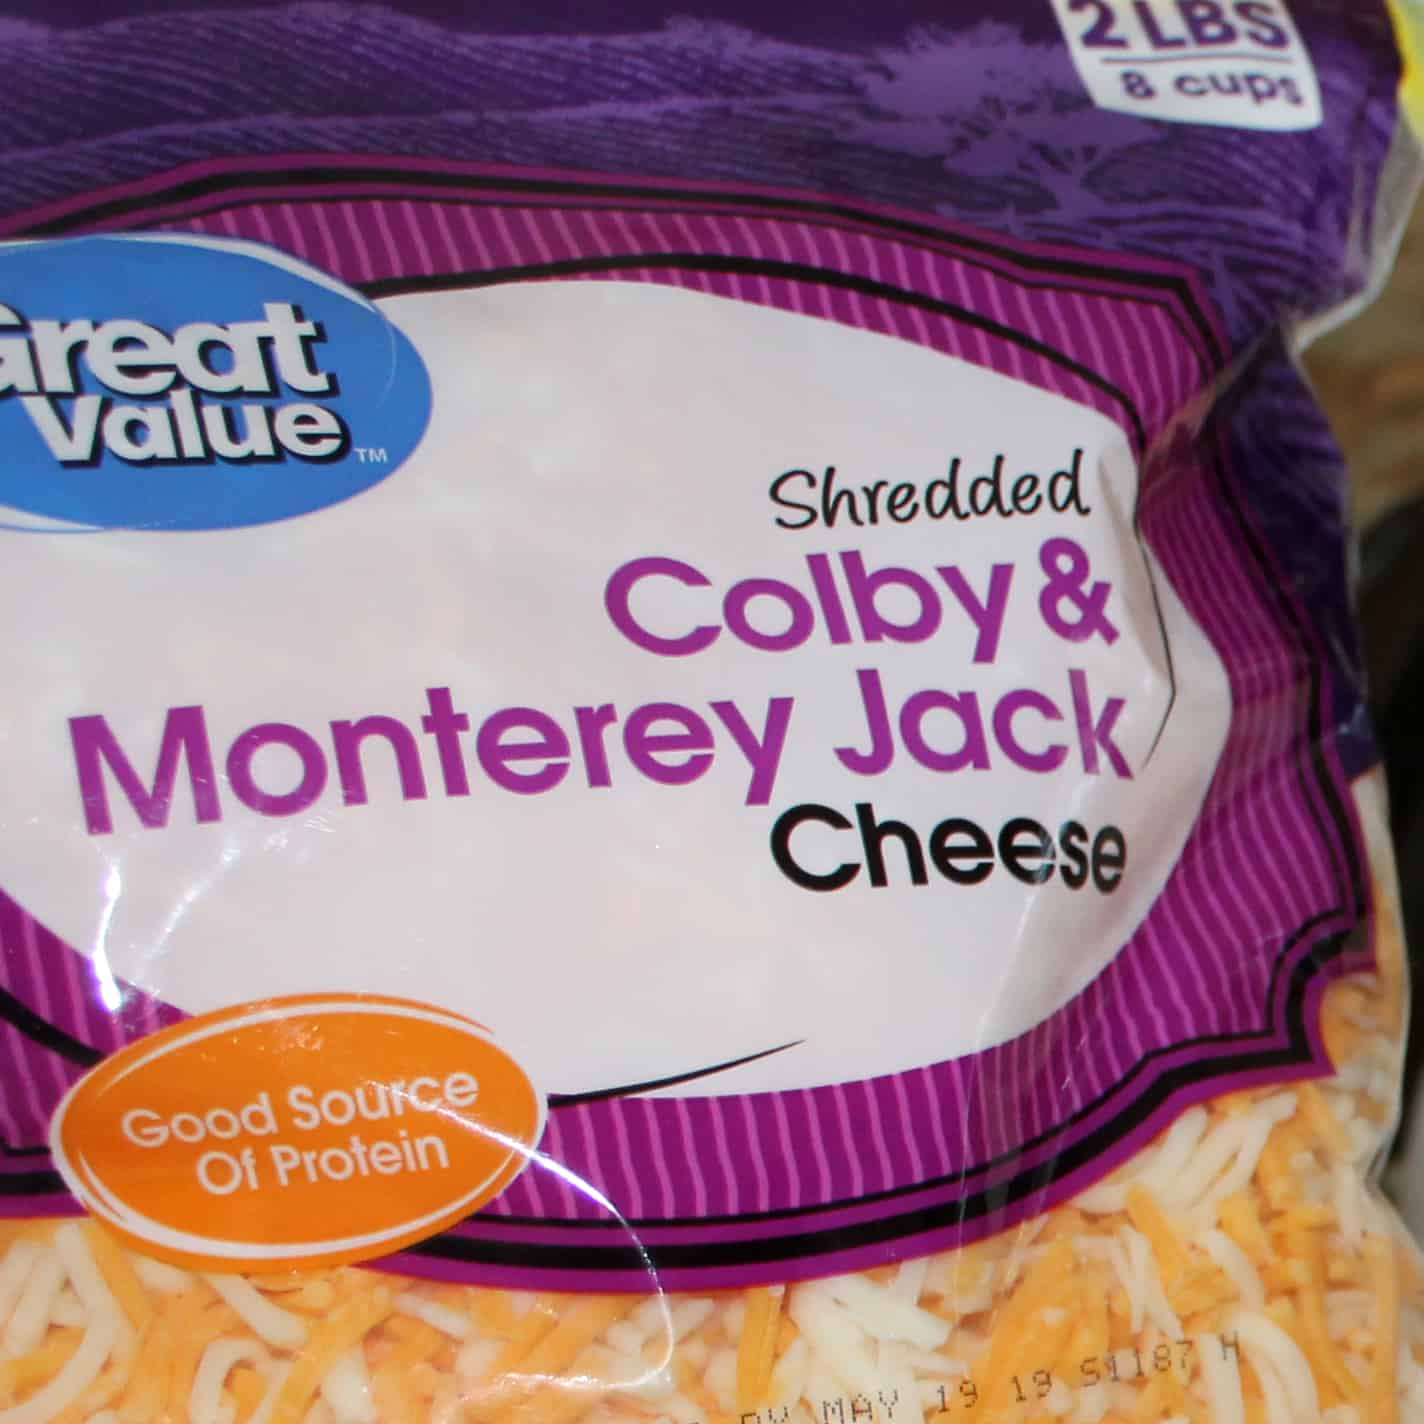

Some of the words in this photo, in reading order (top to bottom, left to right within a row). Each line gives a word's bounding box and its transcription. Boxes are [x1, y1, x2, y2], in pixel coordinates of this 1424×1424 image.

[1174, 72, 1303, 106] cups
[20, 388, 348, 466] Value
[769, 448, 1091, 530] Shredded
[603, 550, 1015, 664] Colby
[1038, 536, 1119, 646] &
[68, 686, 795, 835] Monterey
[832, 667, 1135, 781] Jack
[769, 802, 1127, 895] Cheese
[121, 1092, 278, 1148] Good
[287, 1071, 480, 1131] Source
[197, 1147, 259, 1195] Of
[269, 1130, 449, 1187] Protein
[937, 1378, 978, 1413] 19
